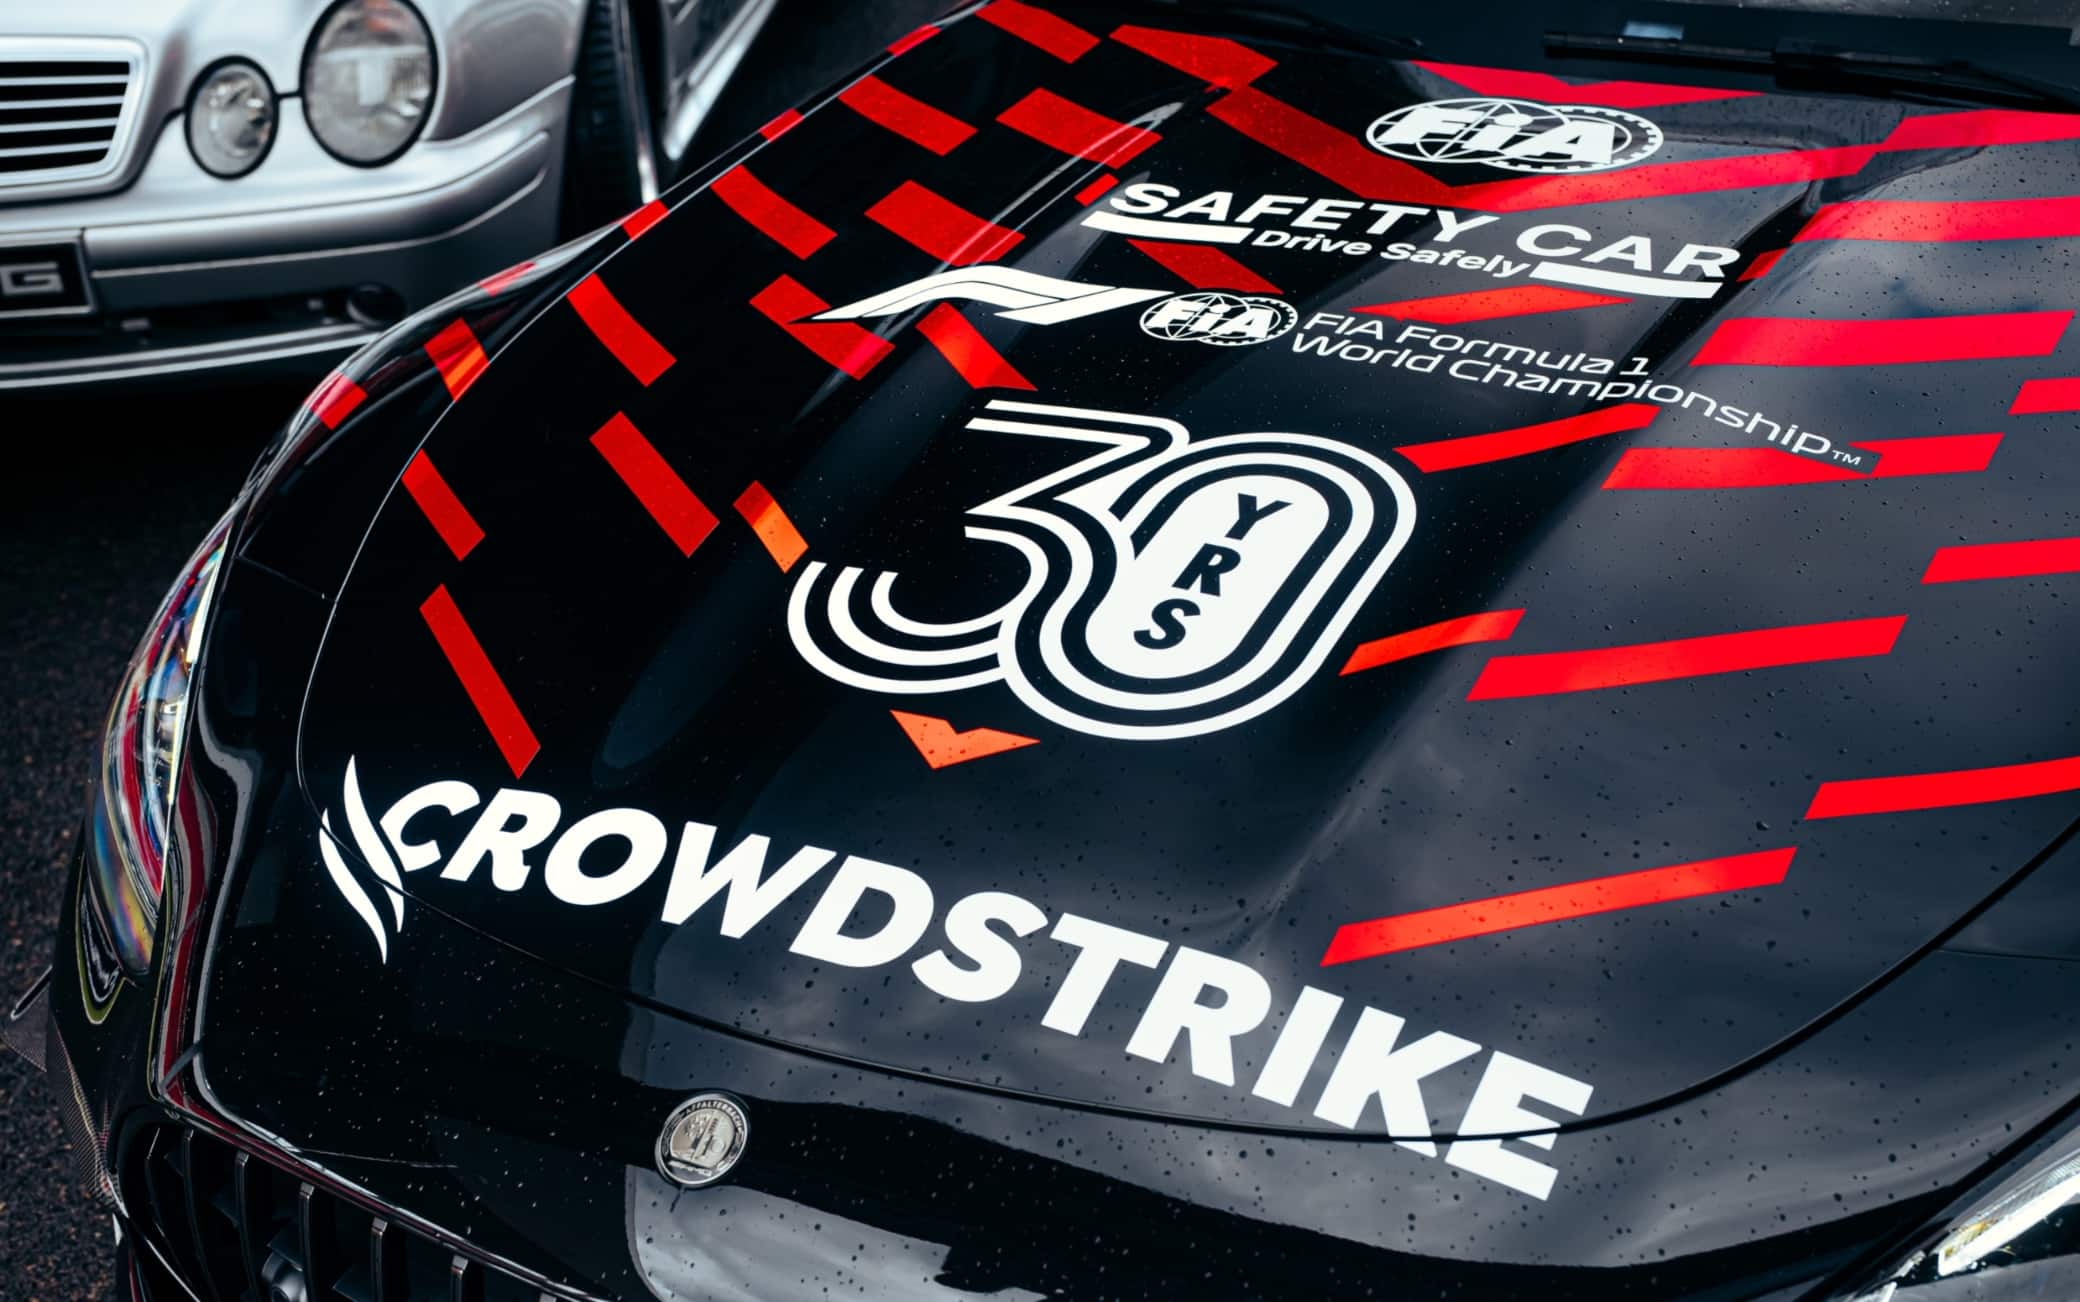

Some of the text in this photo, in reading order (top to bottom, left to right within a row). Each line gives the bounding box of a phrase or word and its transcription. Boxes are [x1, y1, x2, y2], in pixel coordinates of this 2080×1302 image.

[1109, 182, 1741, 278] SAFETY CAR
[1252, 230, 1532, 279] Drive Safely
[1291, 332, 1445, 374] World
[1303, 311, 1650, 376] FIA Formula 1
[787, 398, 1418, 742] 30
[1132, 492, 1295, 650] YRS
[379, 779, 1595, 1202] CROWDSTRIKE
